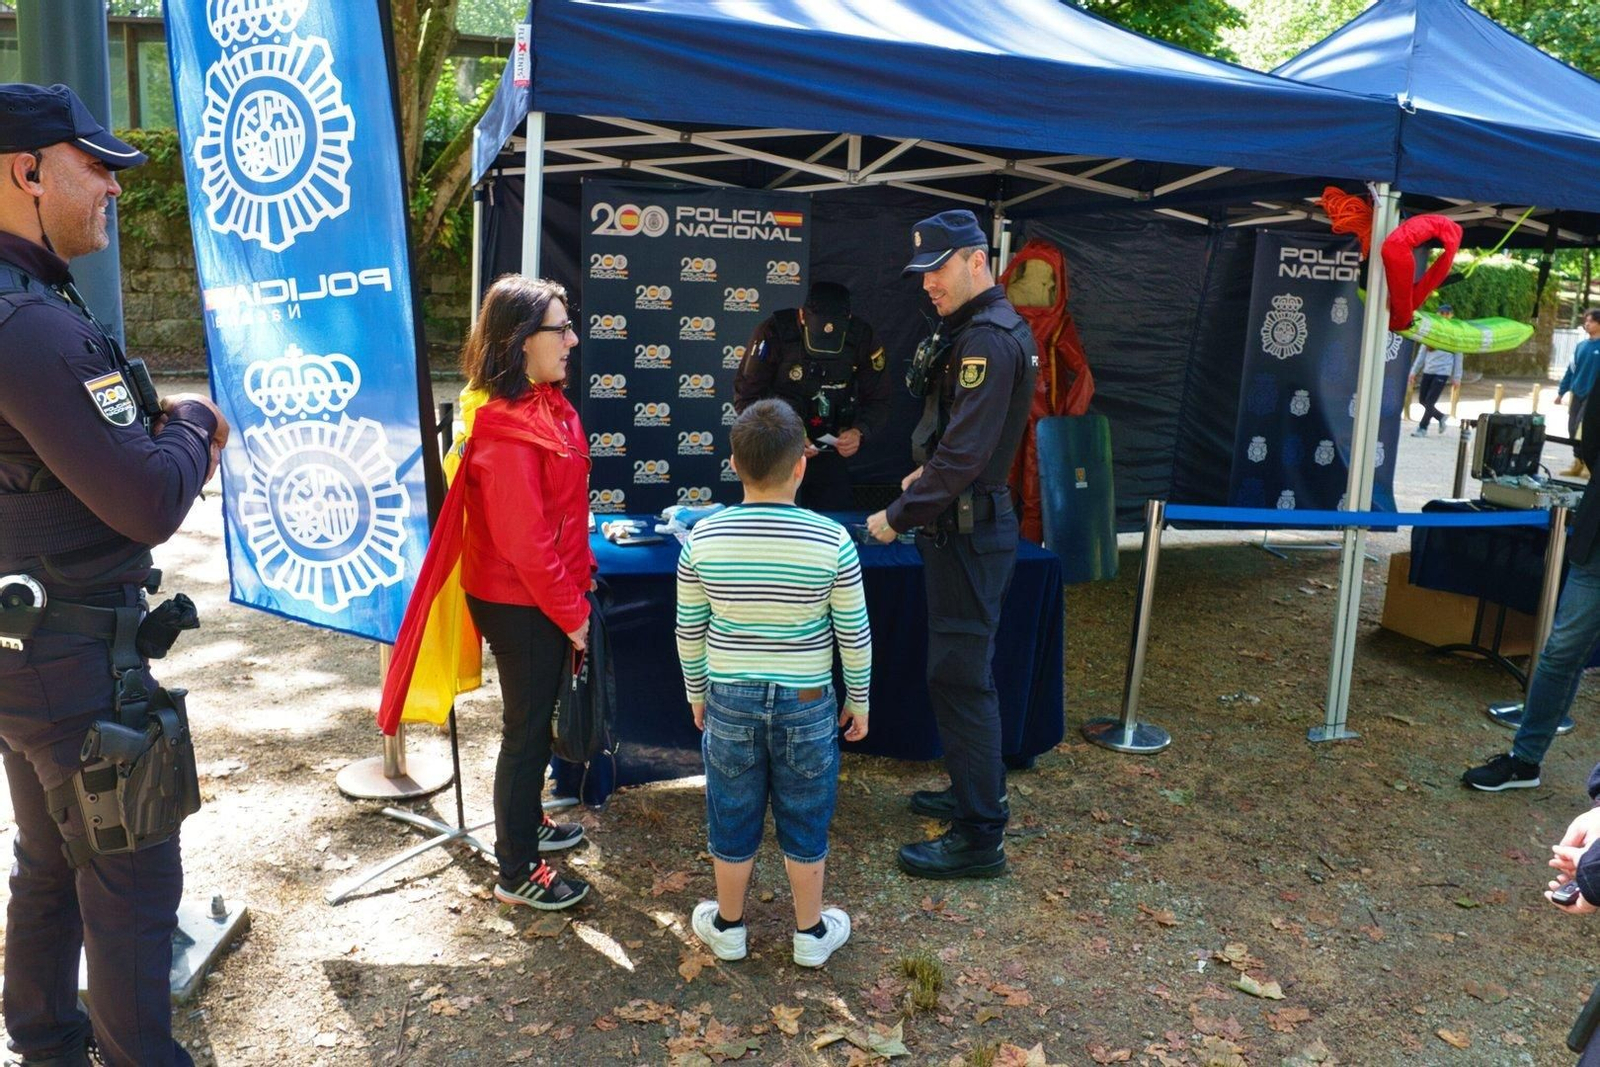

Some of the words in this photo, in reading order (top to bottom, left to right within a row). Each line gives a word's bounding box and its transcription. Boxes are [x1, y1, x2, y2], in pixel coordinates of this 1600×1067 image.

[590, 202, 670, 238] 200
[675, 206, 778, 226] POLICIA
[675, 222, 802, 243] NACIONAL
[590, 253, 628, 270] 200
[681, 257, 717, 273] 200
[766, 260, 800, 276] 200
[635, 285, 672, 301] 200
[724, 287, 759, 303] 200
[590, 314, 627, 330] 200
[680, 316, 716, 332] 200
[635, 344, 671, 360] 200
[723, 345, 746, 361] 20
[590, 373, 626, 389] 200
[679, 374, 714, 389] 200
[96, 385, 127, 407] 200
[634, 402, 671, 417] 200
[589, 432, 626, 448] 200
[678, 431, 713, 446] 200
[634, 460, 669, 475] 200
[589, 489, 625, 504] 200
[677, 487, 712, 502] 200
